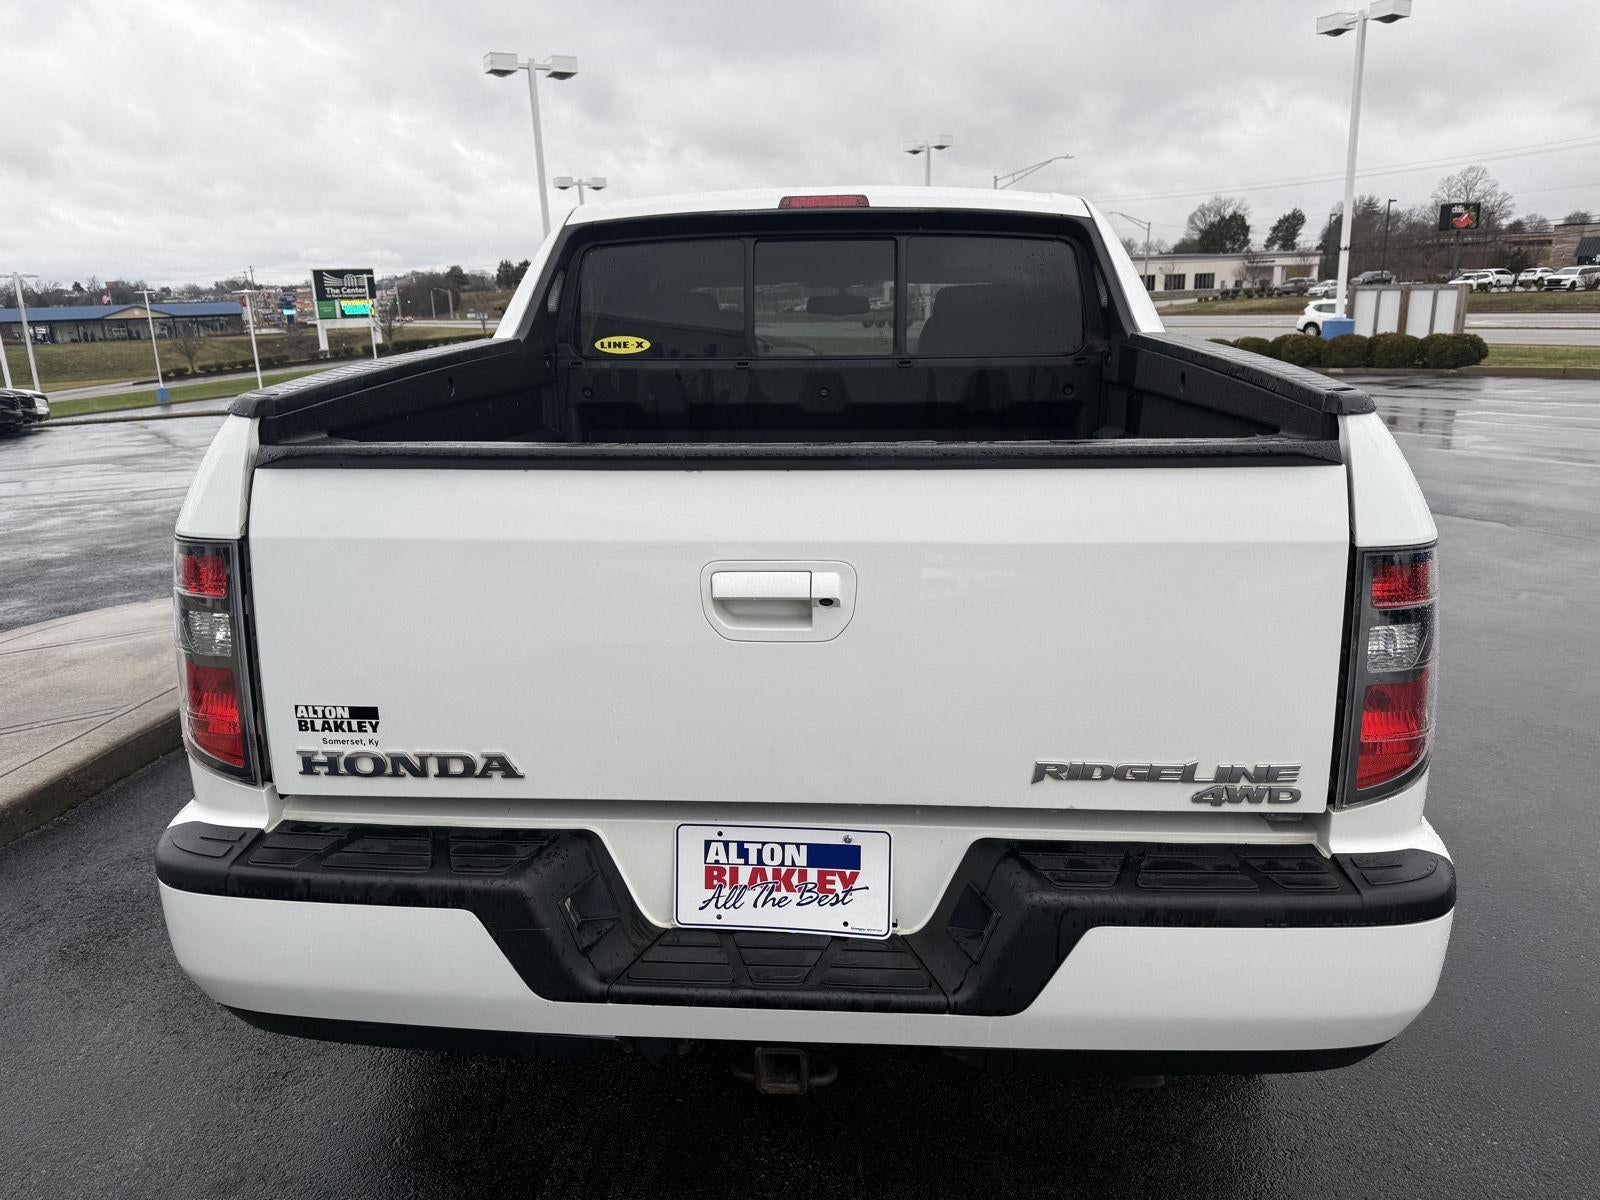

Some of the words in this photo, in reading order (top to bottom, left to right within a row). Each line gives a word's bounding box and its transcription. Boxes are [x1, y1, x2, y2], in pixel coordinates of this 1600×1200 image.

[600, 341, 644, 349] LINE-X
[296, 706, 350, 719] ALTON
[297, 720, 380, 733] BLAKLEY
[322, 737, 366, 747] Somerset,
[368, 738, 379, 747] Ky
[296, 750, 525, 778] HONDA
[1031, 760, 1302, 784] RIDGELINE
[1191, 785, 1302, 807] 4WD
[705, 842, 808, 867] ALTON
[704, 865, 860, 895] BLAKLEY
[699, 883, 746, 910] All
[751, 880, 791, 908] The
[795, 881, 870, 907] Best
